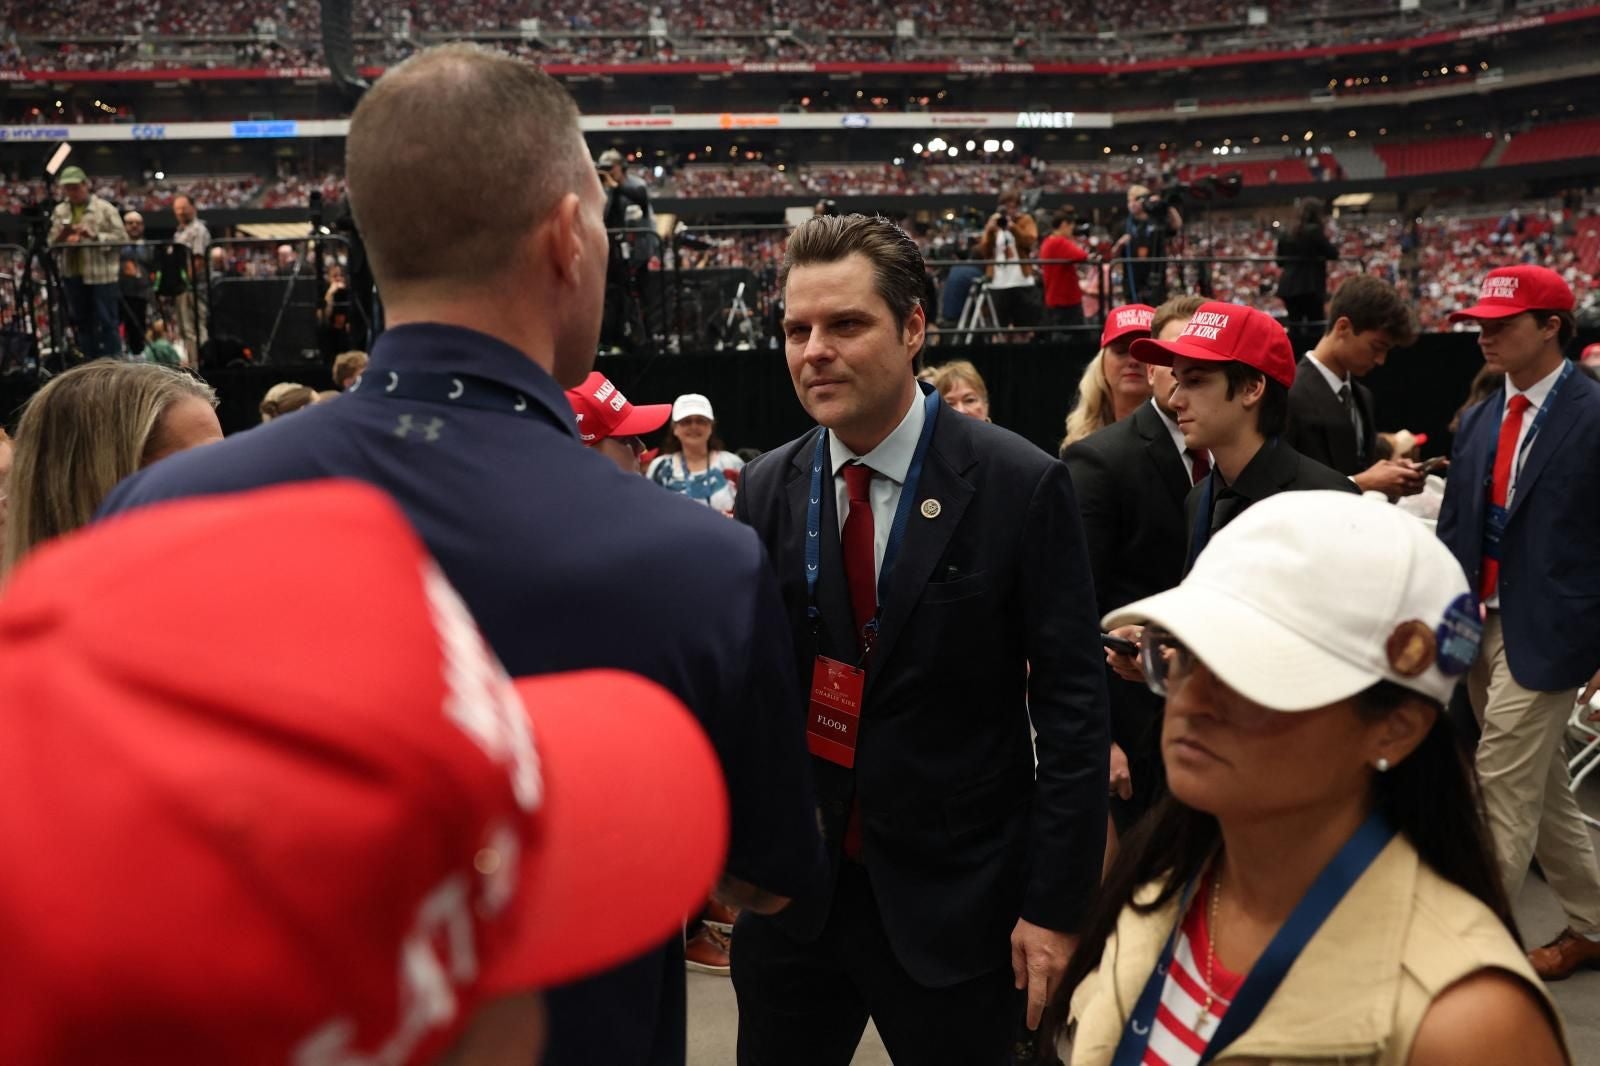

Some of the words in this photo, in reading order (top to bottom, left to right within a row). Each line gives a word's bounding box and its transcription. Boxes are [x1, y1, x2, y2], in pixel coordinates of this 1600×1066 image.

[1016, 112, 1074, 128] AVNET
[131, 126, 166, 139] COX
[1191, 311, 1229, 328] AMERICA
[1193, 325, 1221, 340] KIRK
[817, 714, 848, 733] FLOOR
